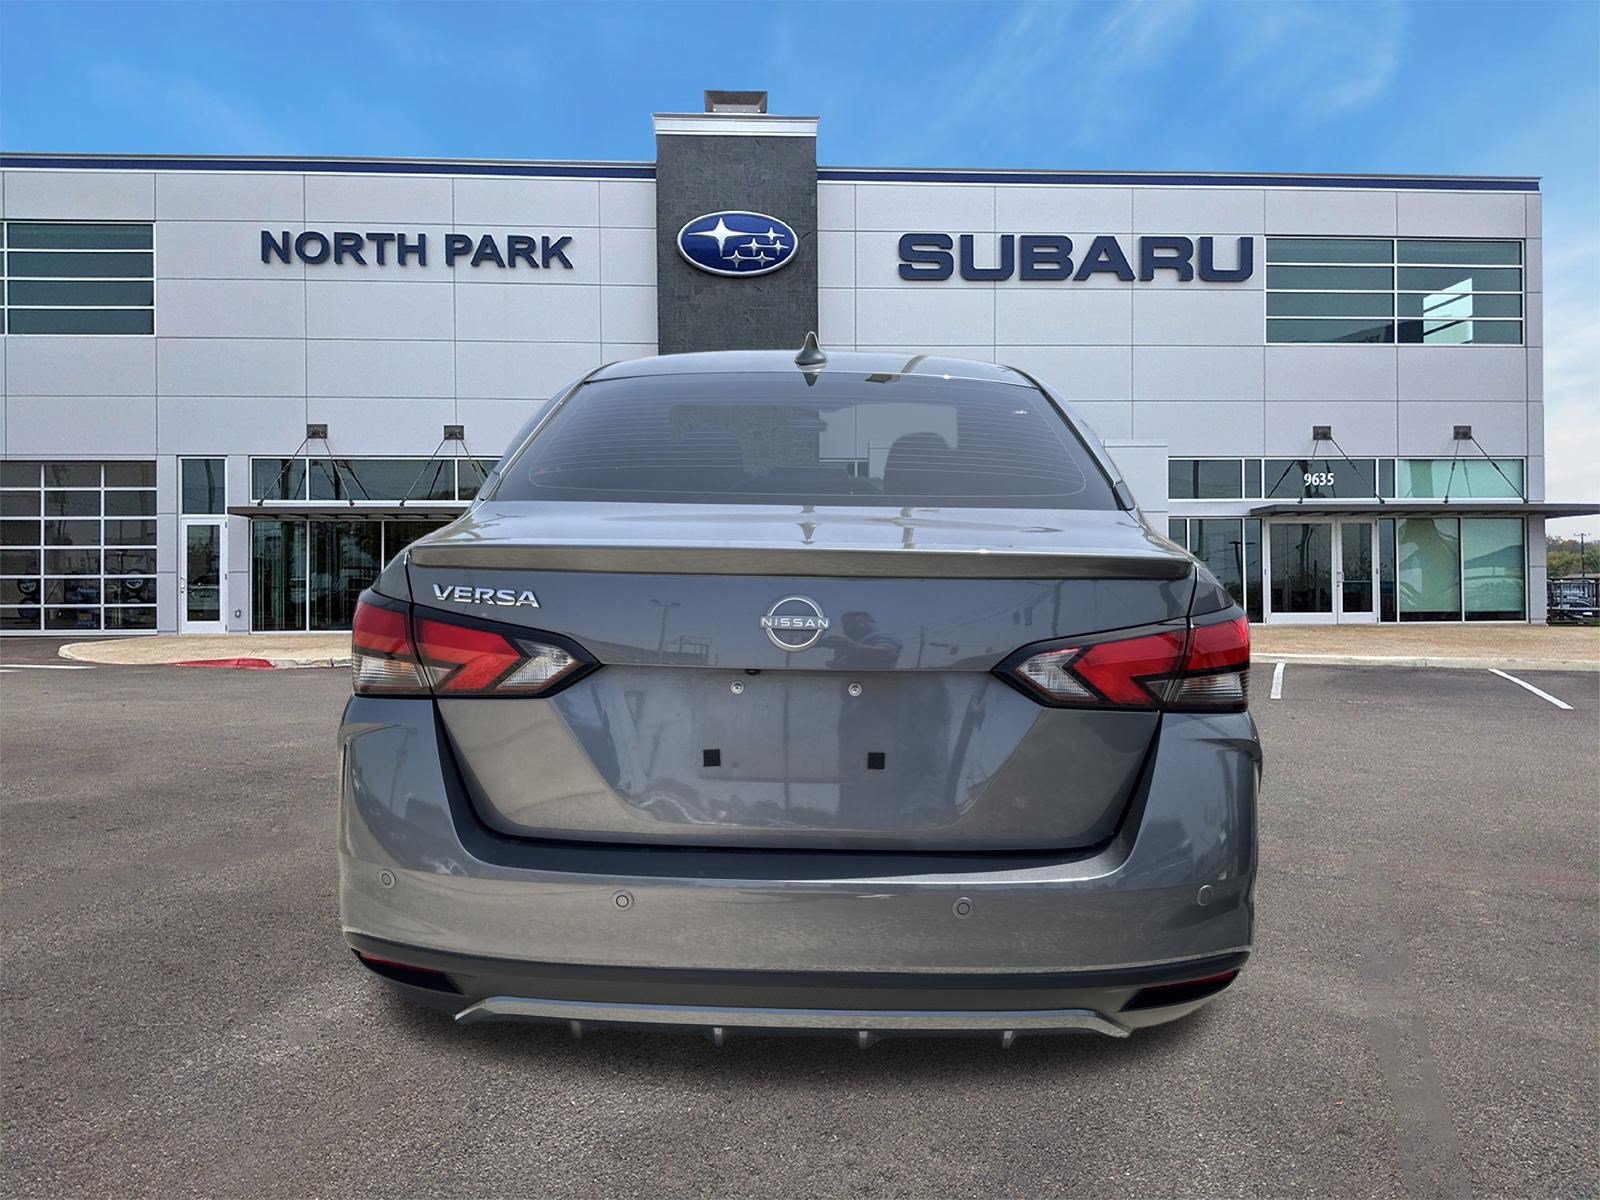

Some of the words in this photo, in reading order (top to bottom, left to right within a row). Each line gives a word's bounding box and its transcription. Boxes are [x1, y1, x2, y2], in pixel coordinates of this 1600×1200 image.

[260, 230, 427, 266] NORTH
[445, 233, 574, 270] PARK
[898, 232, 1254, 283] SUBARU
[1303, 472, 1335, 487] 9635
[432, 583, 541, 608] VERSA
[760, 617, 830, 629] NISSAN
